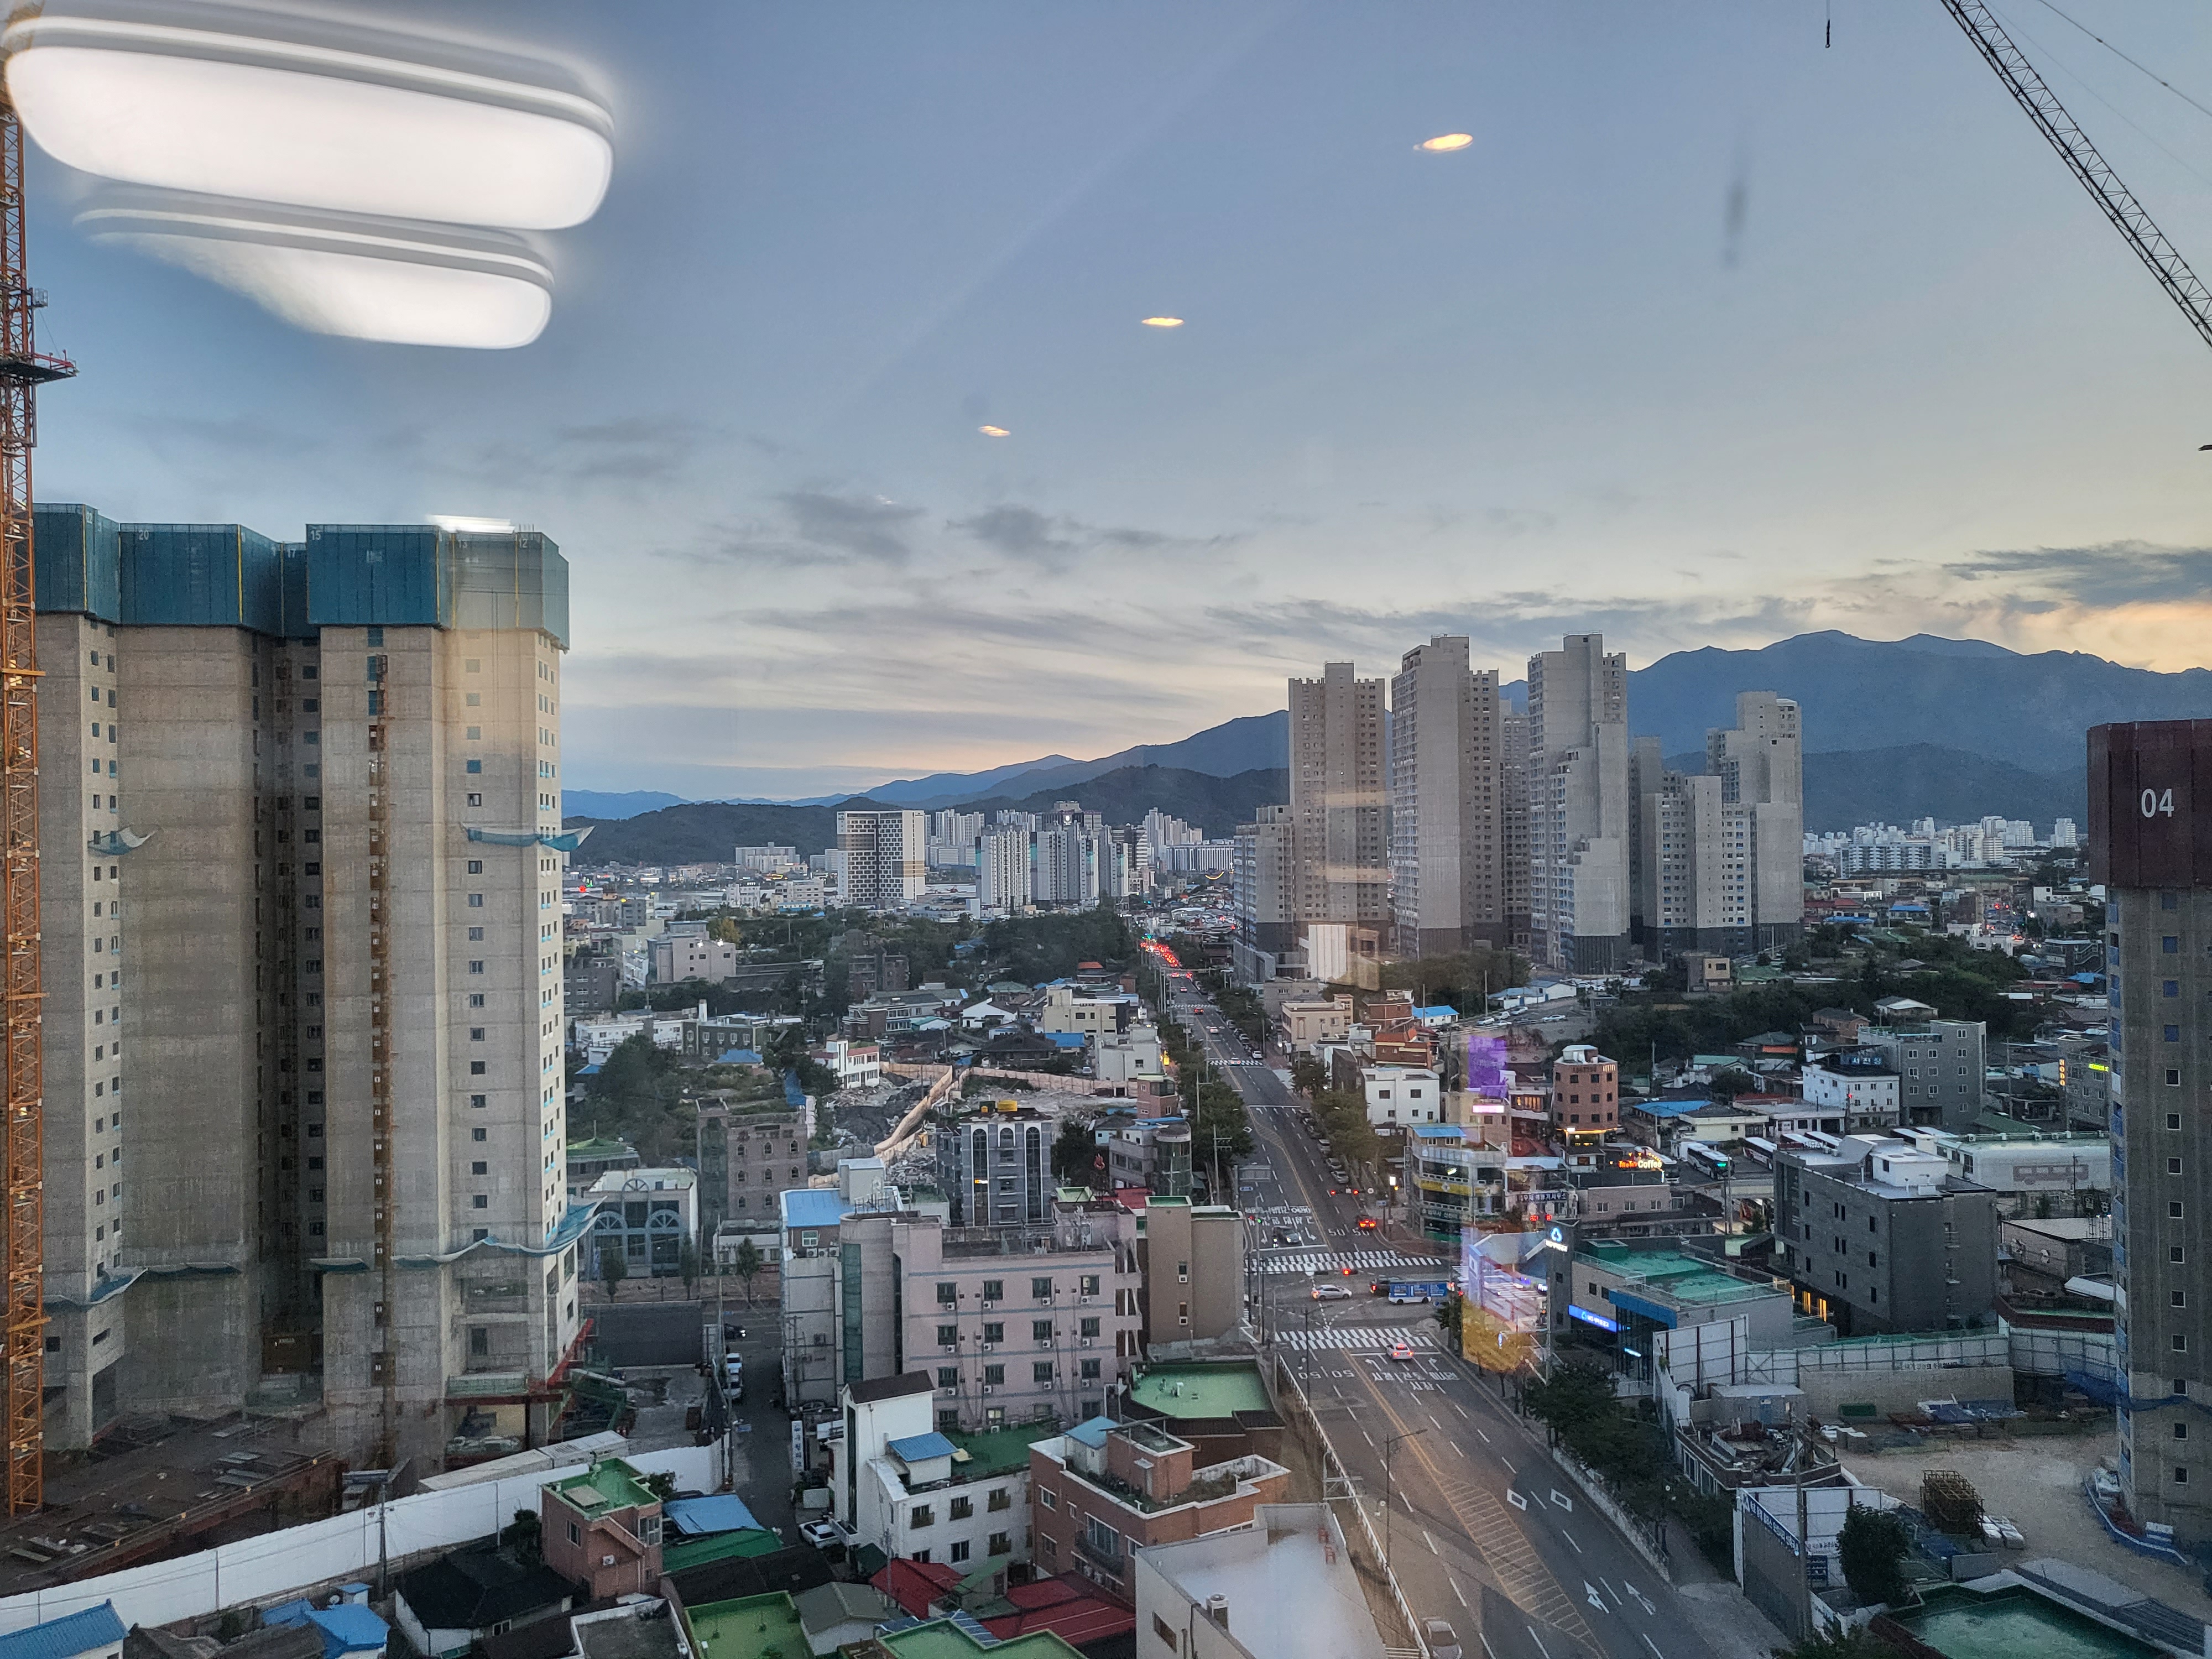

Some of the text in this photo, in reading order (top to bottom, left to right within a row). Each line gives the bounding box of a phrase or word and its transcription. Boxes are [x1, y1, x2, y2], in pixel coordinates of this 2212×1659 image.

[138, 530, 149, 540] 20
[311, 530, 321, 540] 15
[2141, 788, 2174, 818] 04
